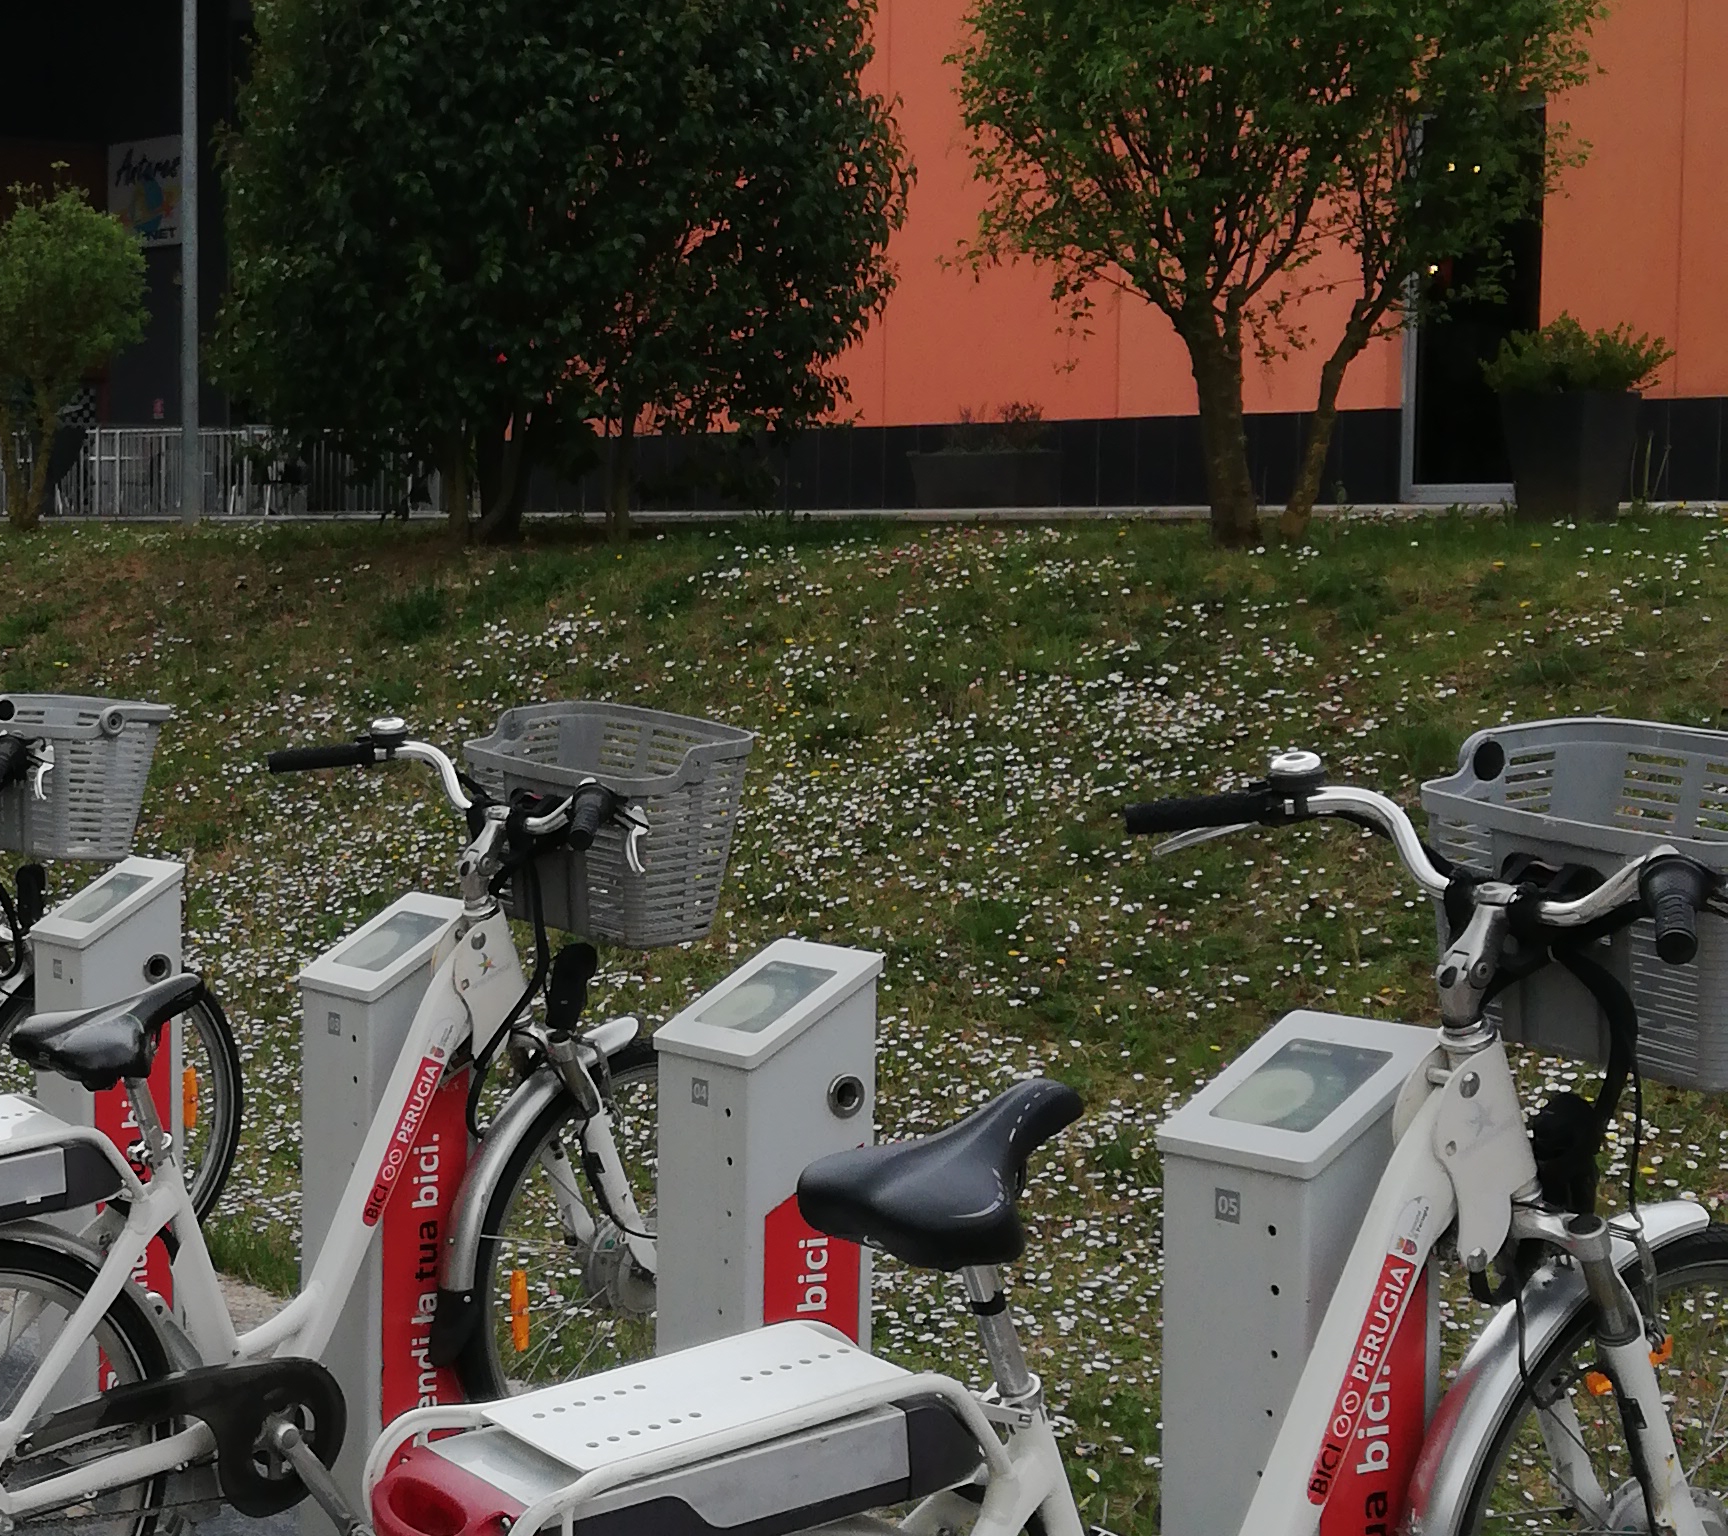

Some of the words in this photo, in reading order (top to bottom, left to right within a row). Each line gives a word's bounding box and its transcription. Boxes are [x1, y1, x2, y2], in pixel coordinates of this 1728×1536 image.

[693, 1083, 707, 1100] 04
[365, 1183, 389, 1220] BICI
[396, 1066, 440, 1144] PERUGIA
[411, 1133, 440, 1209] bici.
[1218, 1195, 1238, 1216] 05
[415, 1220, 438, 1282] tua
[411, 1292, 438, 1324] la
[1309, 1443, 1342, 1496] BICI
[1352, 1265, 1411, 1383] PERUGIA
[1357, 1365, 1392, 1476] bici.
